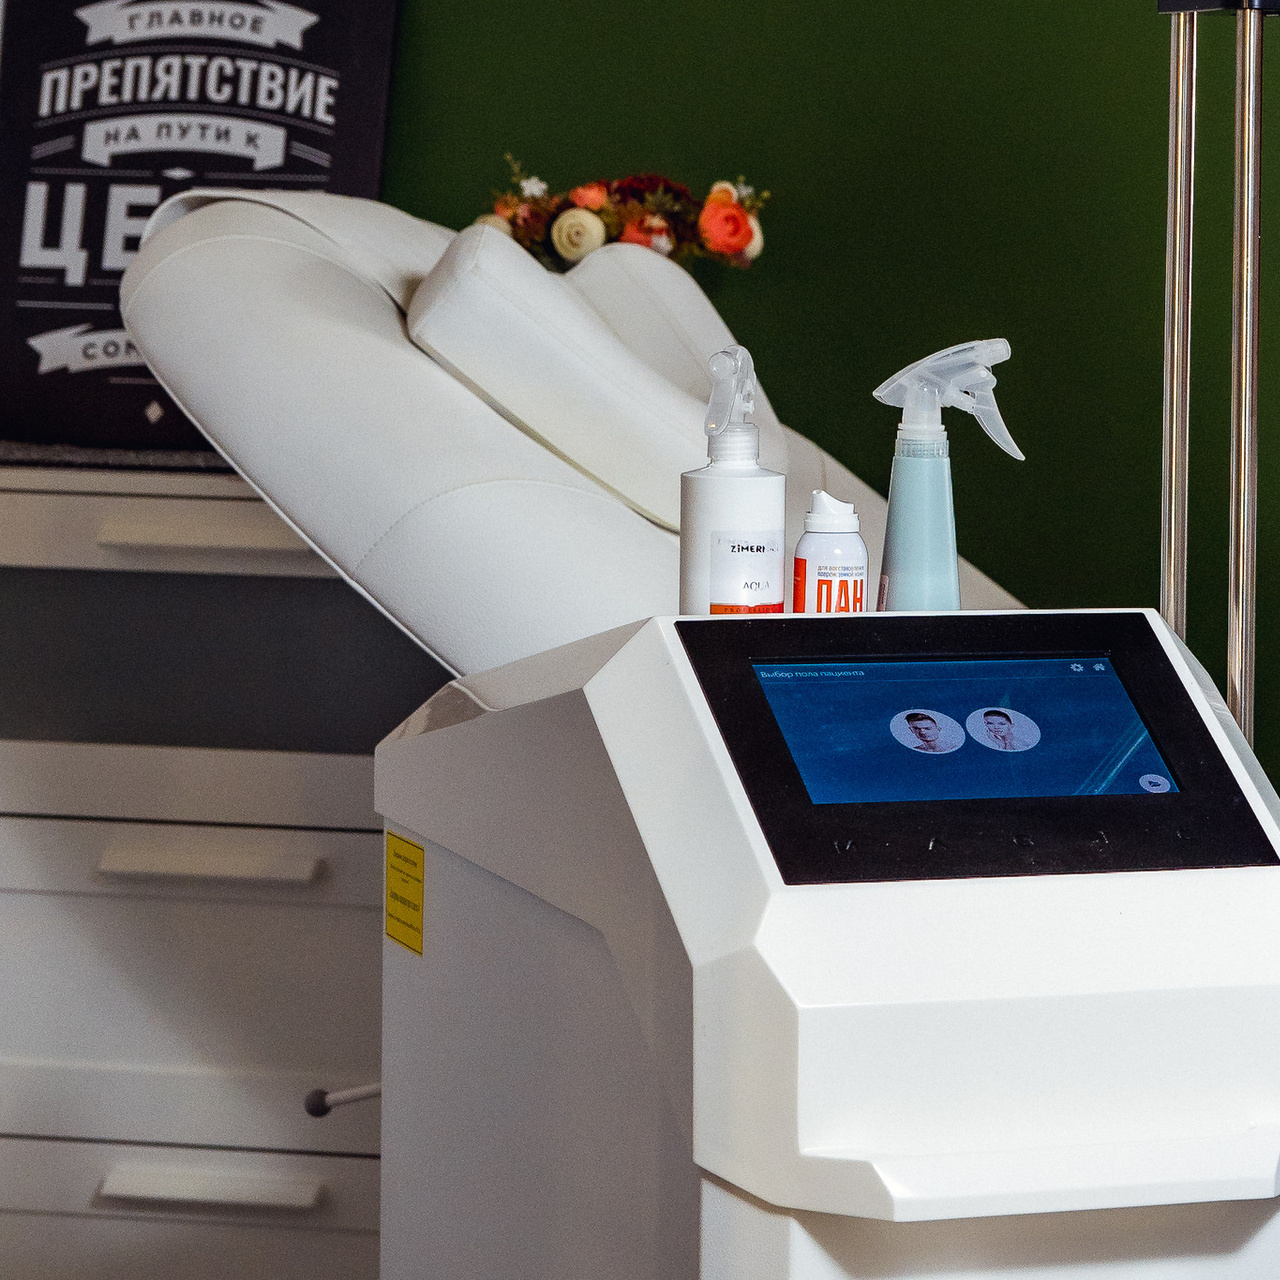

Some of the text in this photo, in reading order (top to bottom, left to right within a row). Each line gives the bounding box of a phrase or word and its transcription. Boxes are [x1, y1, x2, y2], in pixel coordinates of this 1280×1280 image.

[128, 9, 265, 34] ГЛАВНОЕ
[38, 54, 340, 126] ПРЕПЯТСТВИЕ
[104, 122, 260, 150] НА ПУТИ К
[819, 670, 865, 678] пациента
